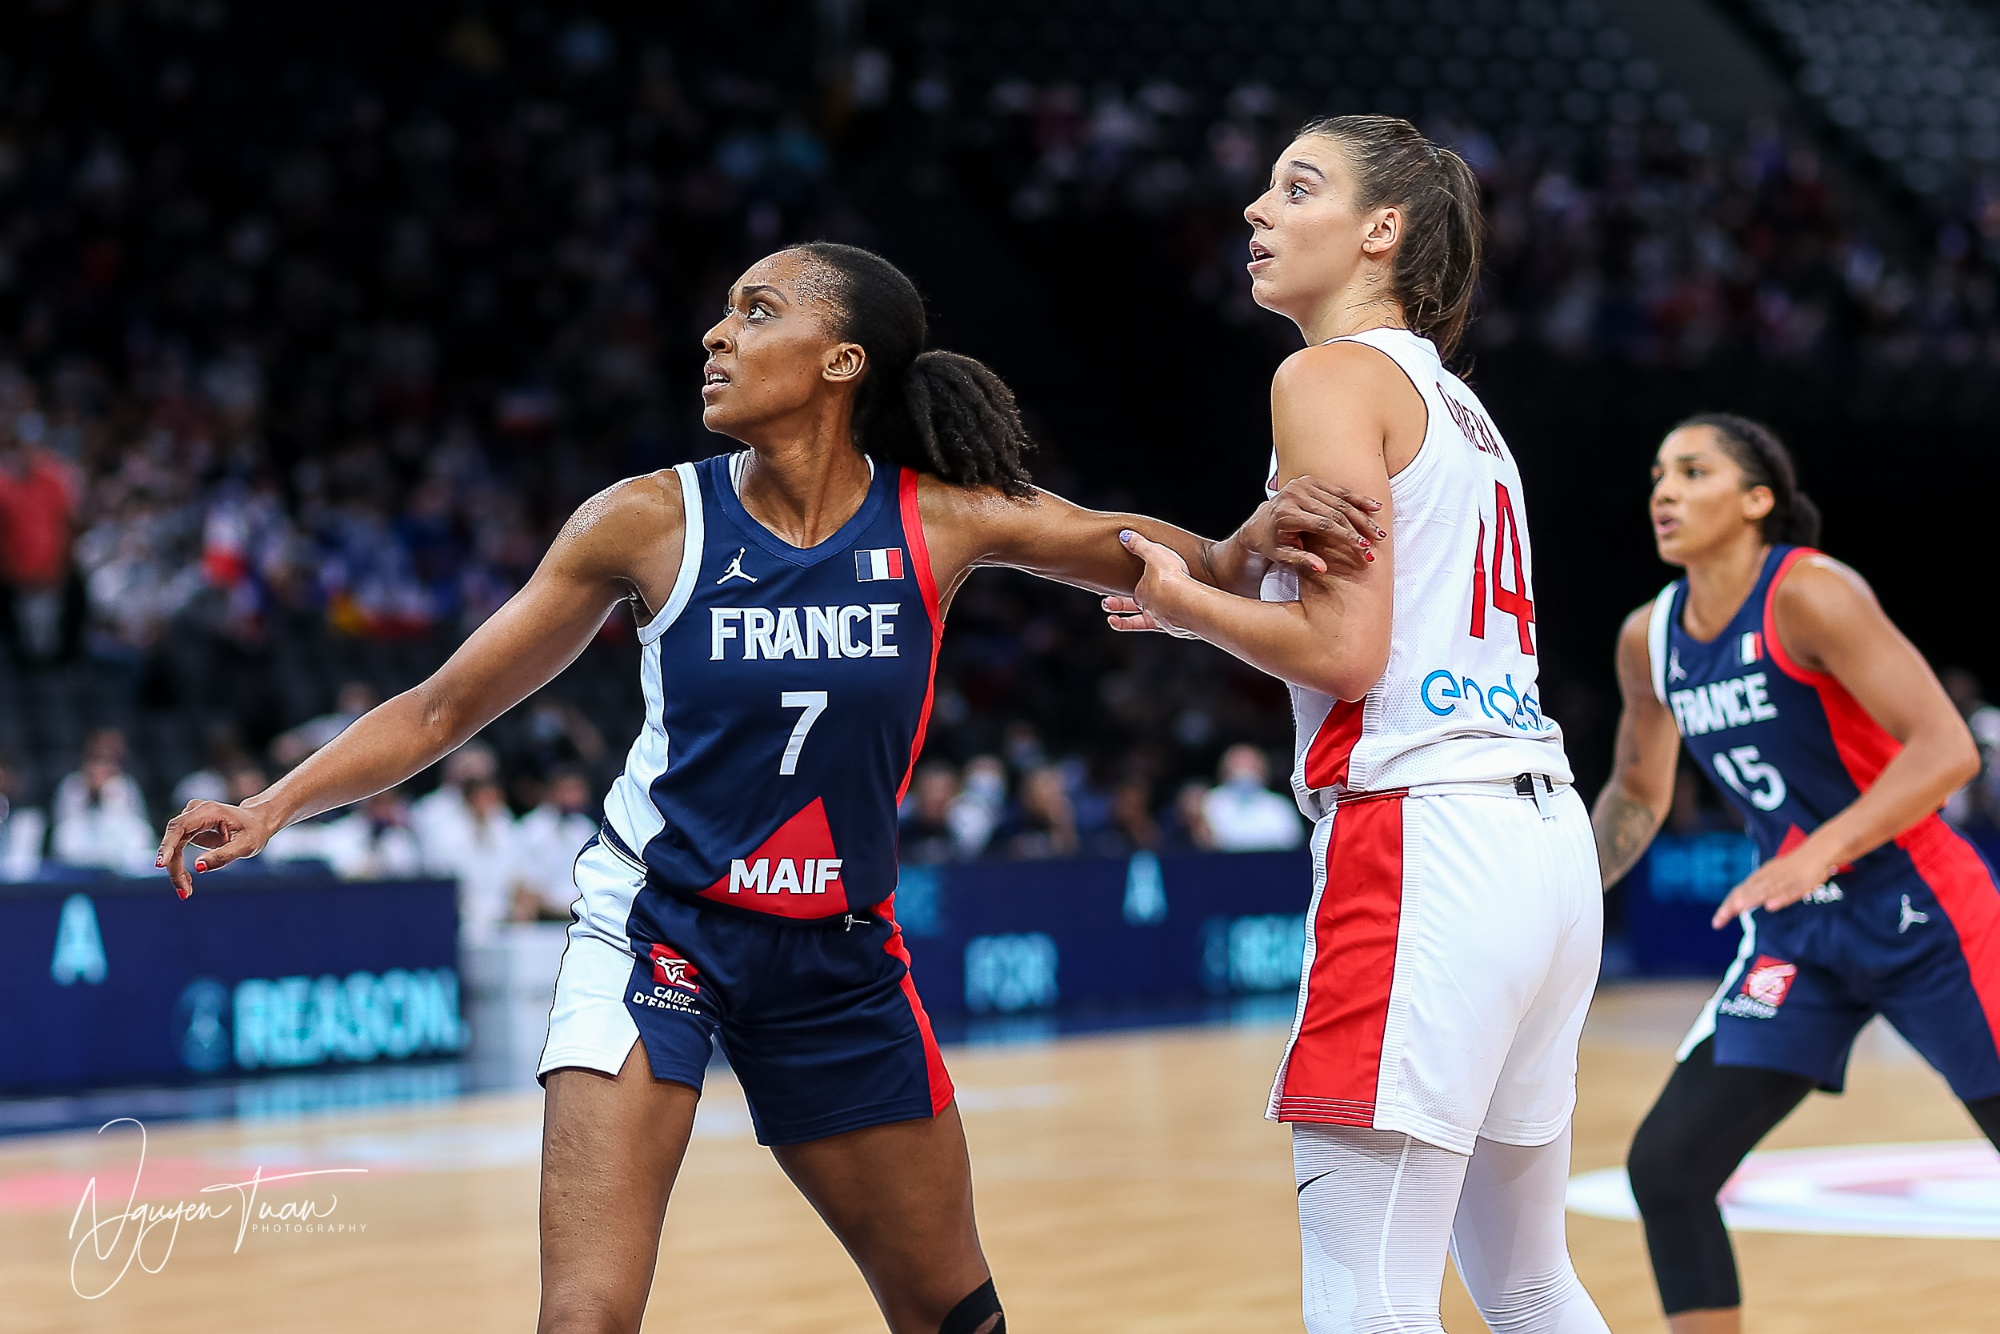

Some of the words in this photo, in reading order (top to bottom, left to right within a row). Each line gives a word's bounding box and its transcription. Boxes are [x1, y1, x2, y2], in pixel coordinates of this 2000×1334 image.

[1469, 480, 1536, 656] 14
[709, 603, 900, 660] FRANCE
[779, 691, 828, 776] 7
[1670, 672, 1778, 737] FRANCE
[1712, 745, 1787, 811] 15
[728, 858, 843, 894] MAIF
[51, 894, 107, 985] A
